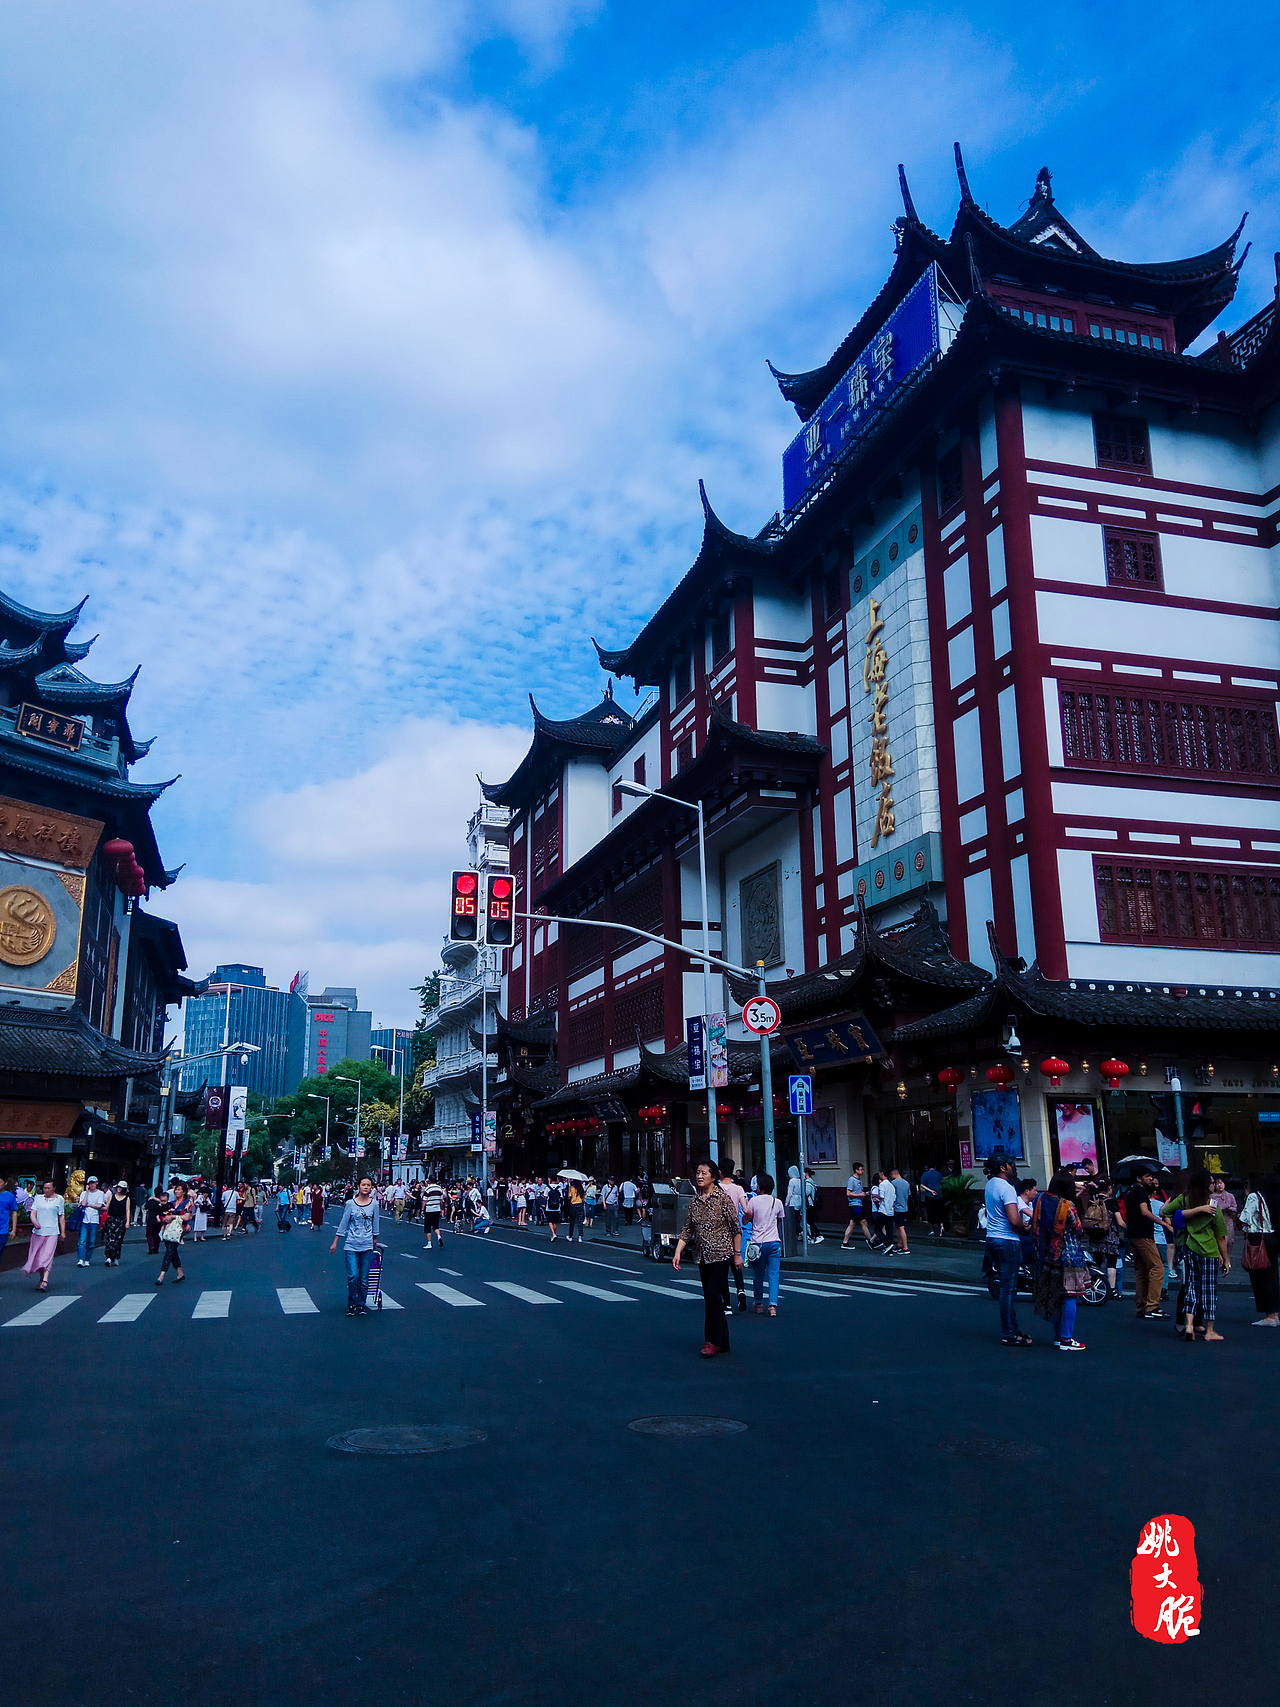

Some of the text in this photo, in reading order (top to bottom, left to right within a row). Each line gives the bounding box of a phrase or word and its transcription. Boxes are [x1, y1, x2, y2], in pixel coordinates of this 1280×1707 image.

[455, 897, 474, 914] 05
[490, 901, 509, 918] 05
[314, 1013, 334, 1022] PICC
[750, 1009, 775, 1022] 3.5m
